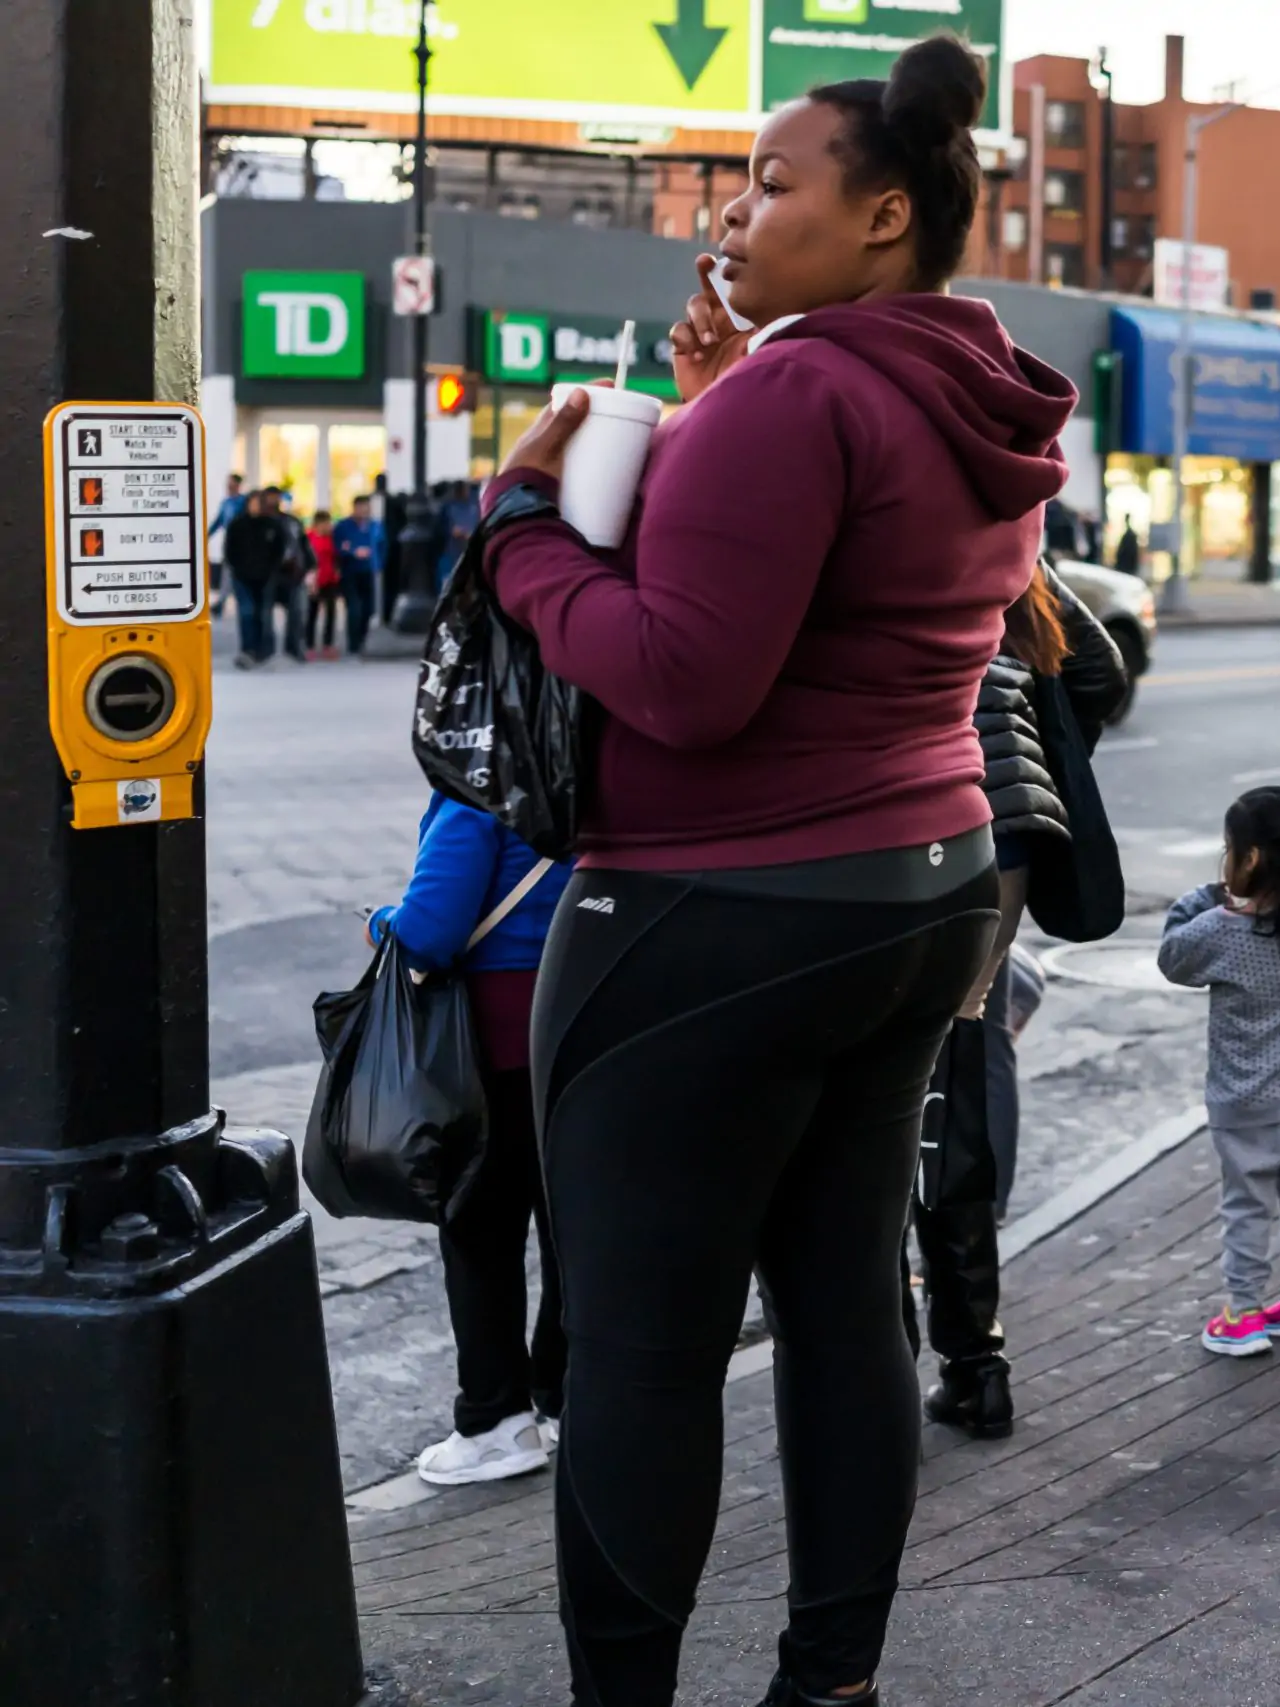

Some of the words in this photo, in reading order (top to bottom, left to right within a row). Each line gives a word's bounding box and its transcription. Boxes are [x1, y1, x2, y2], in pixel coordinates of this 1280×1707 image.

[257, 291, 349, 357] TD
[109, 424, 133, 435] START
[138, 424, 178, 435] CROSSING
[124, 440, 146, 449] Watch
[124, 473, 148, 484] DON'T
[152, 473, 176, 483] START
[149, 487, 180, 499] Crossing
[120, 534, 144, 544] DON'T
[148, 533, 174, 543] CROSS
[96, 572, 124, 582] PUSH
[128, 571, 168, 582] BUTTON
[107, 594, 120, 604] TO
[124, 593, 158, 603] CROSS
